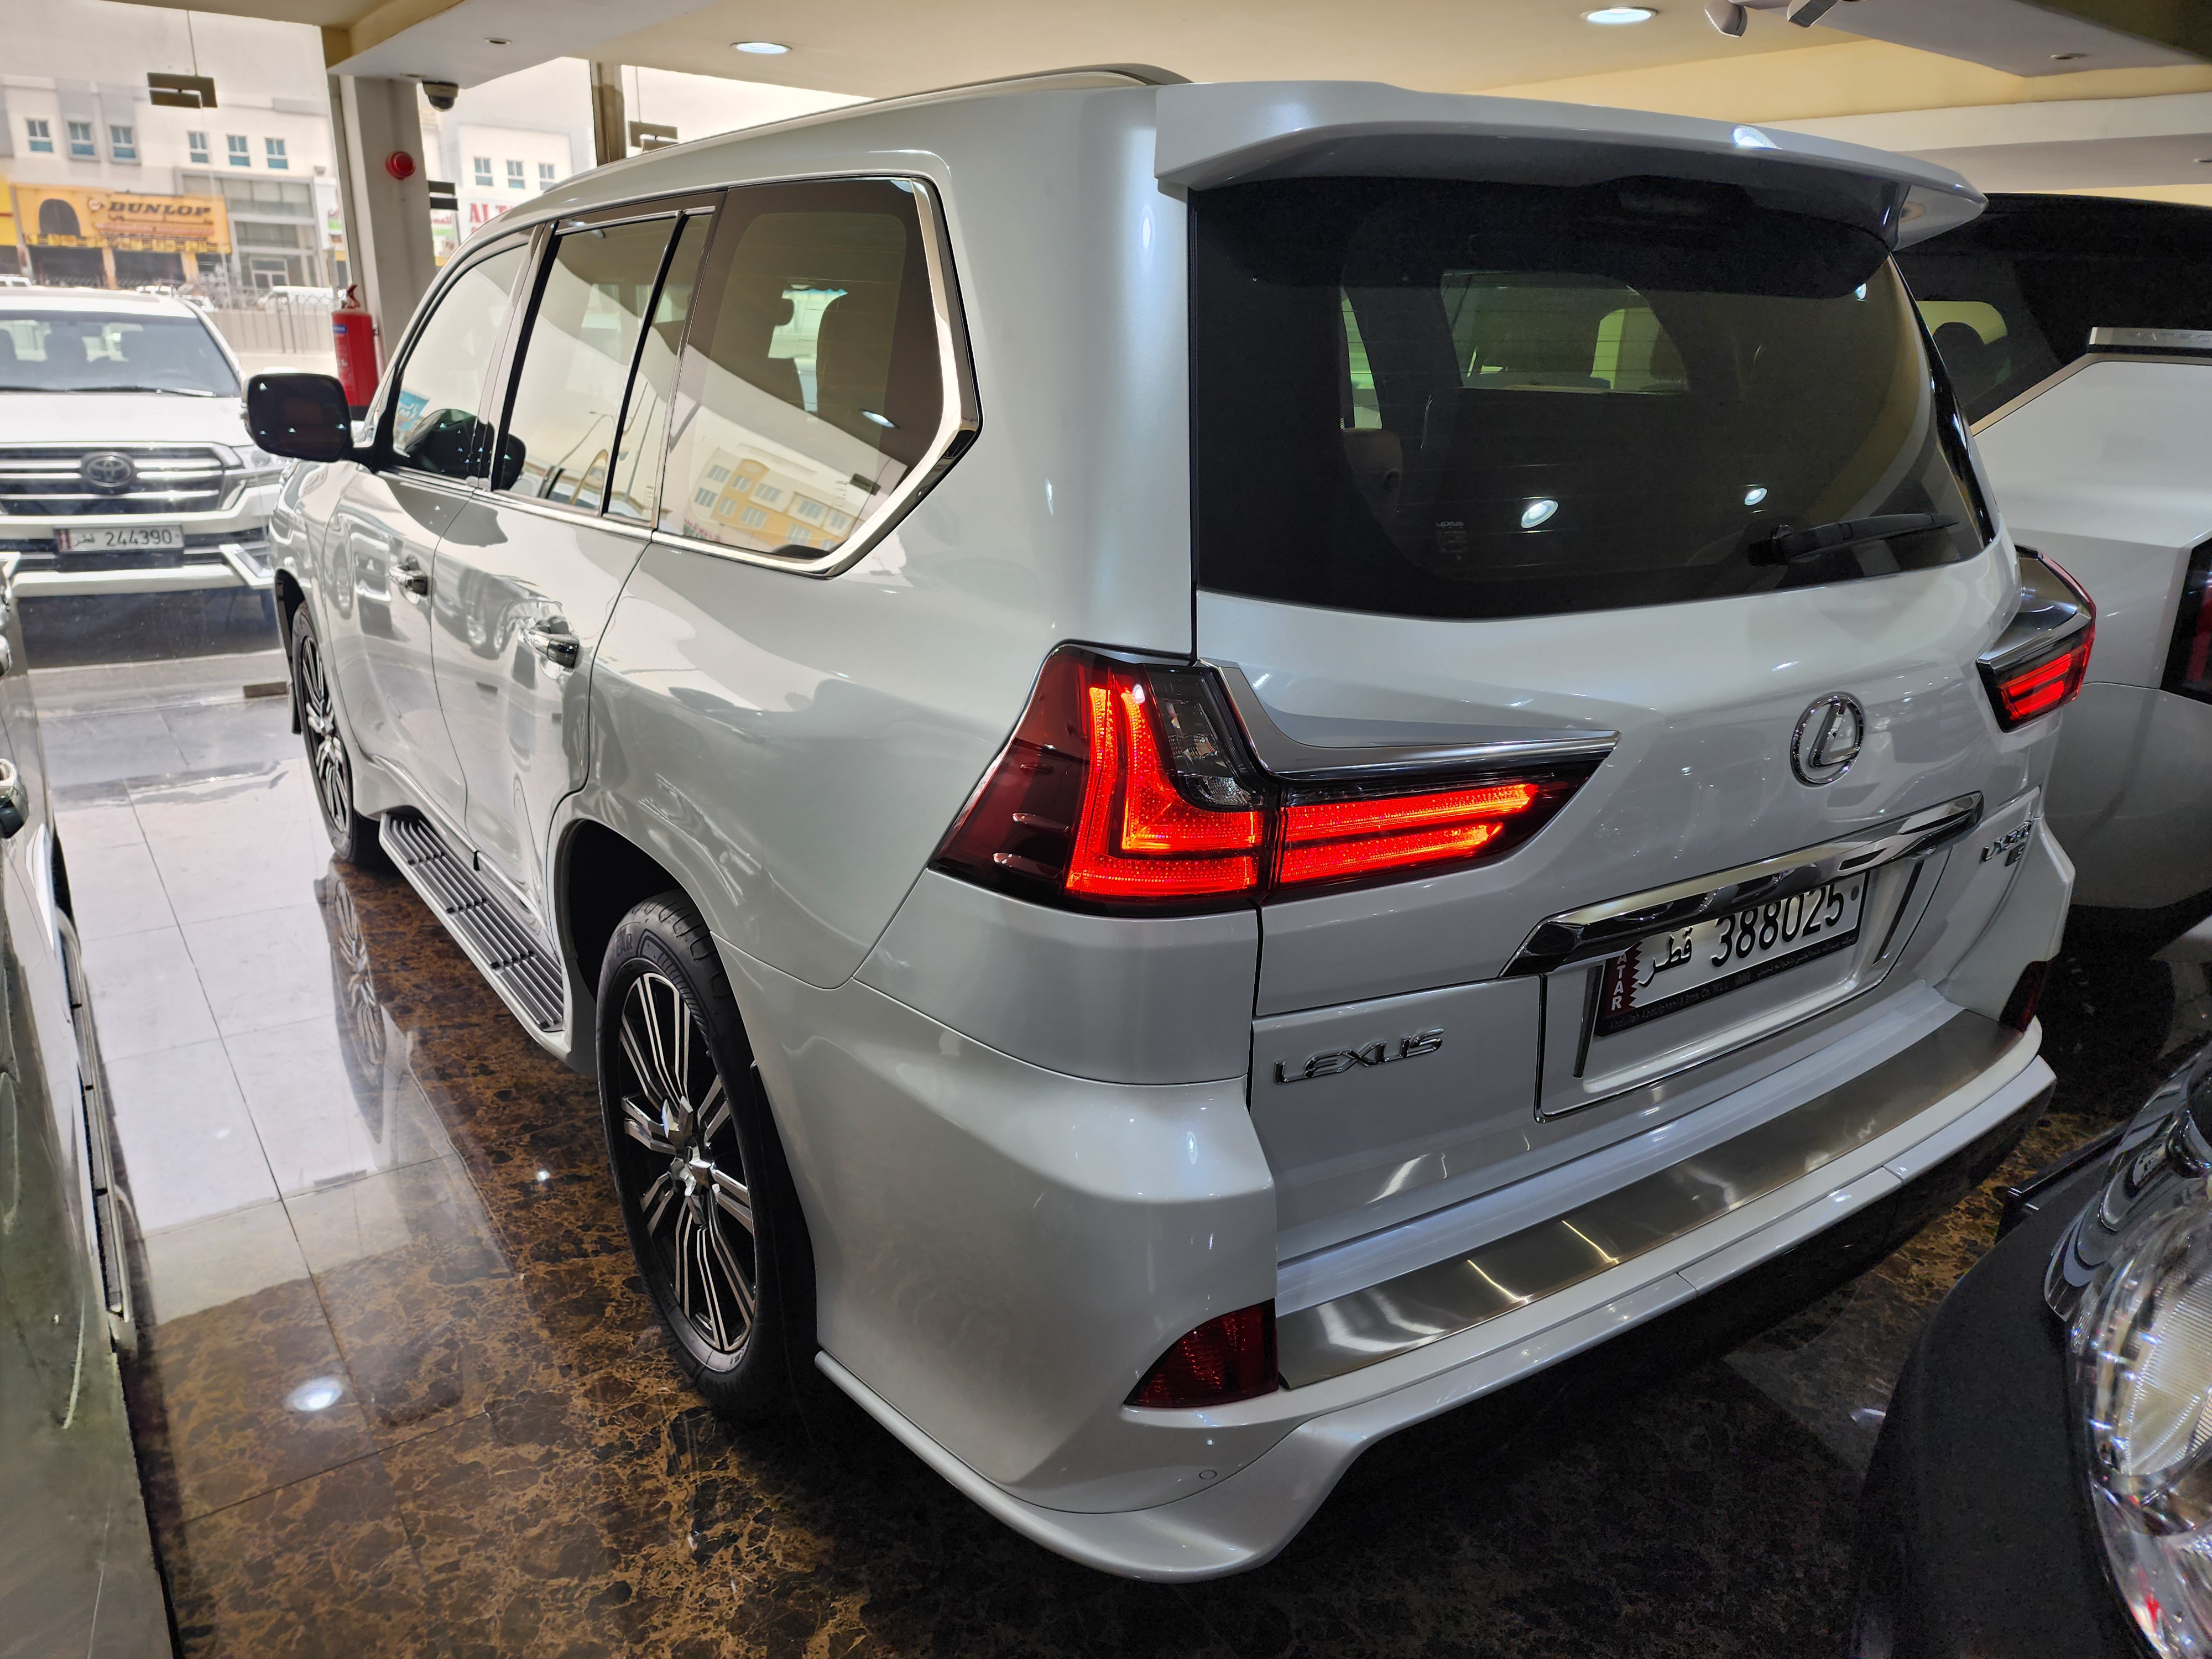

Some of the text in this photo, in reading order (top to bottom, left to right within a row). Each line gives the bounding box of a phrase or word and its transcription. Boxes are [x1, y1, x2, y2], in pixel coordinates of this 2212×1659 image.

[109, 202, 211, 216] DUNLOP
[105, 529, 172, 546] 244390
[1639, 926, 1693, 988] قطر
[1710, 884, 1844, 968] 388025
[1611, 952, 1627, 1011] ATAR
[1274, 1028, 1444, 1083] LEXUS
